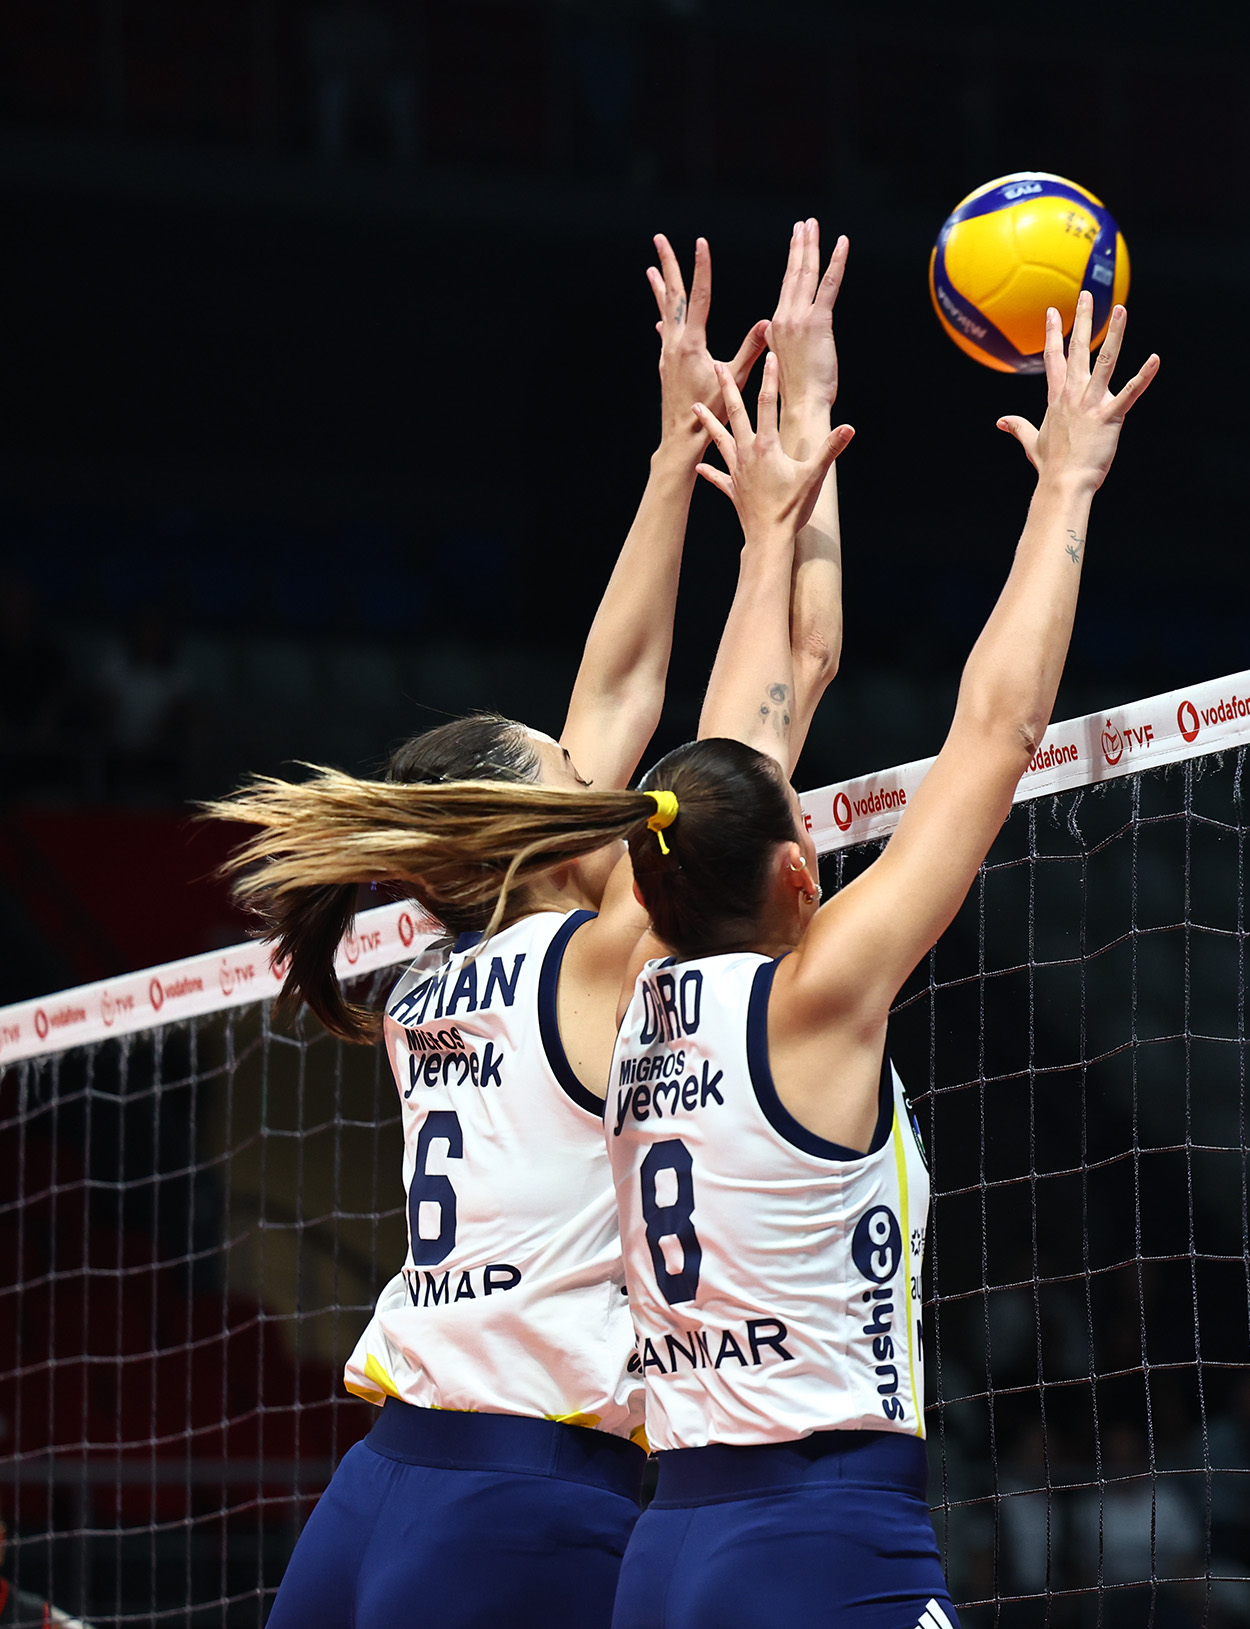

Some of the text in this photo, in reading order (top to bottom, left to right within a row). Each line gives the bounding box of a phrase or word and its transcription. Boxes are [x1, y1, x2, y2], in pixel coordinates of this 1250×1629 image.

[853, 787, 907, 816] vodafone
[1025, 744, 1079, 774] odafone
[1122, 724, 1154, 751] TVF
[233, 963, 256, 986] TVF
[359, 931, 381, 956] TVF
[389, 953, 527, 1027] AMAN
[404, 1041, 505, 1099] yemek
[613, 1059, 725, 1137] yemek
[409, 1110, 463, 1267] 6
[640, 1138, 703, 1305] 8
